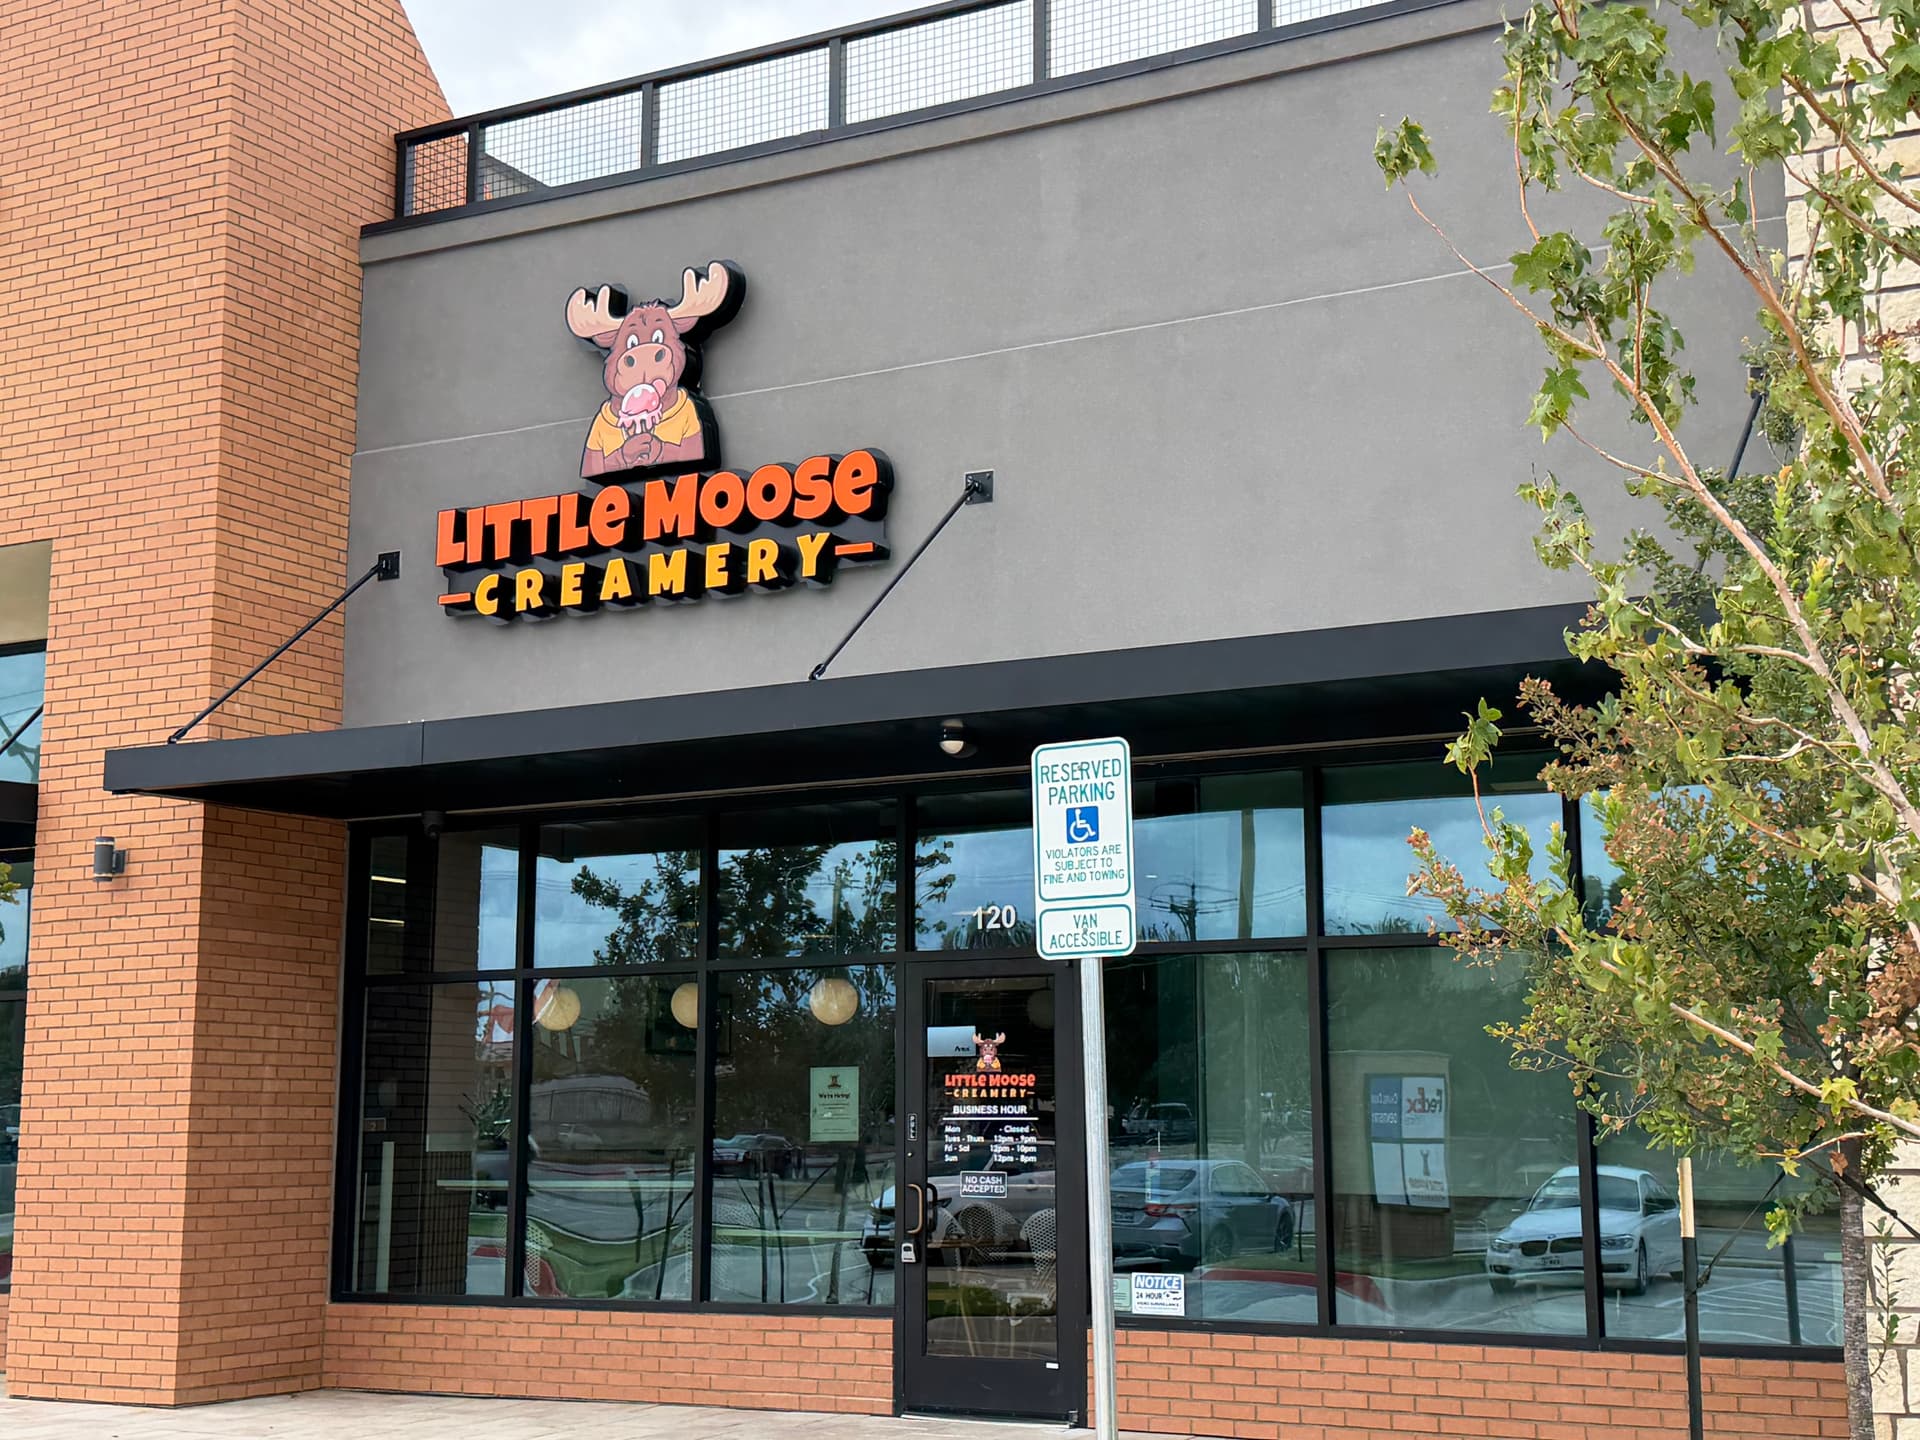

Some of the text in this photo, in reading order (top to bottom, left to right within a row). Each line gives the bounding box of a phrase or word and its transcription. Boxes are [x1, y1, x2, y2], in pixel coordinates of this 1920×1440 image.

[474, 532, 832, 616] CREAMERY
[1040, 758, 1122, 784] RESERVED
[1049, 782, 1115, 805] PARKING
[1045, 844, 1121, 859] VIOLATORS ARE
[1055, 857, 1113, 871] SUBJECT TO
[1043, 869, 1125, 885] FINE AND TOWING
[972, 904, 1016, 930] 120
[1073, 913, 1098, 929] VAN
[1049, 930, 1123, 949] ACCESSIBLE
[953, 1088, 1027, 1098] CREAMERY
[952, 1105, 1028, 1114] BUSINESS HOUR
[944, 1125, 961, 1133] Mon
[1003, 1125, 1030, 1133] Closed
[944, 1154, 958, 1162] Sun
[965, 1175, 1003, 1185] NO CASH
[962, 1185, 1005, 1193] ACCEPTED
[1135, 1275, 1180, 1289] NOTICE
[1136, 1291, 1143, 1299] 24
[1145, 1292, 1162, 1300] HOUR
